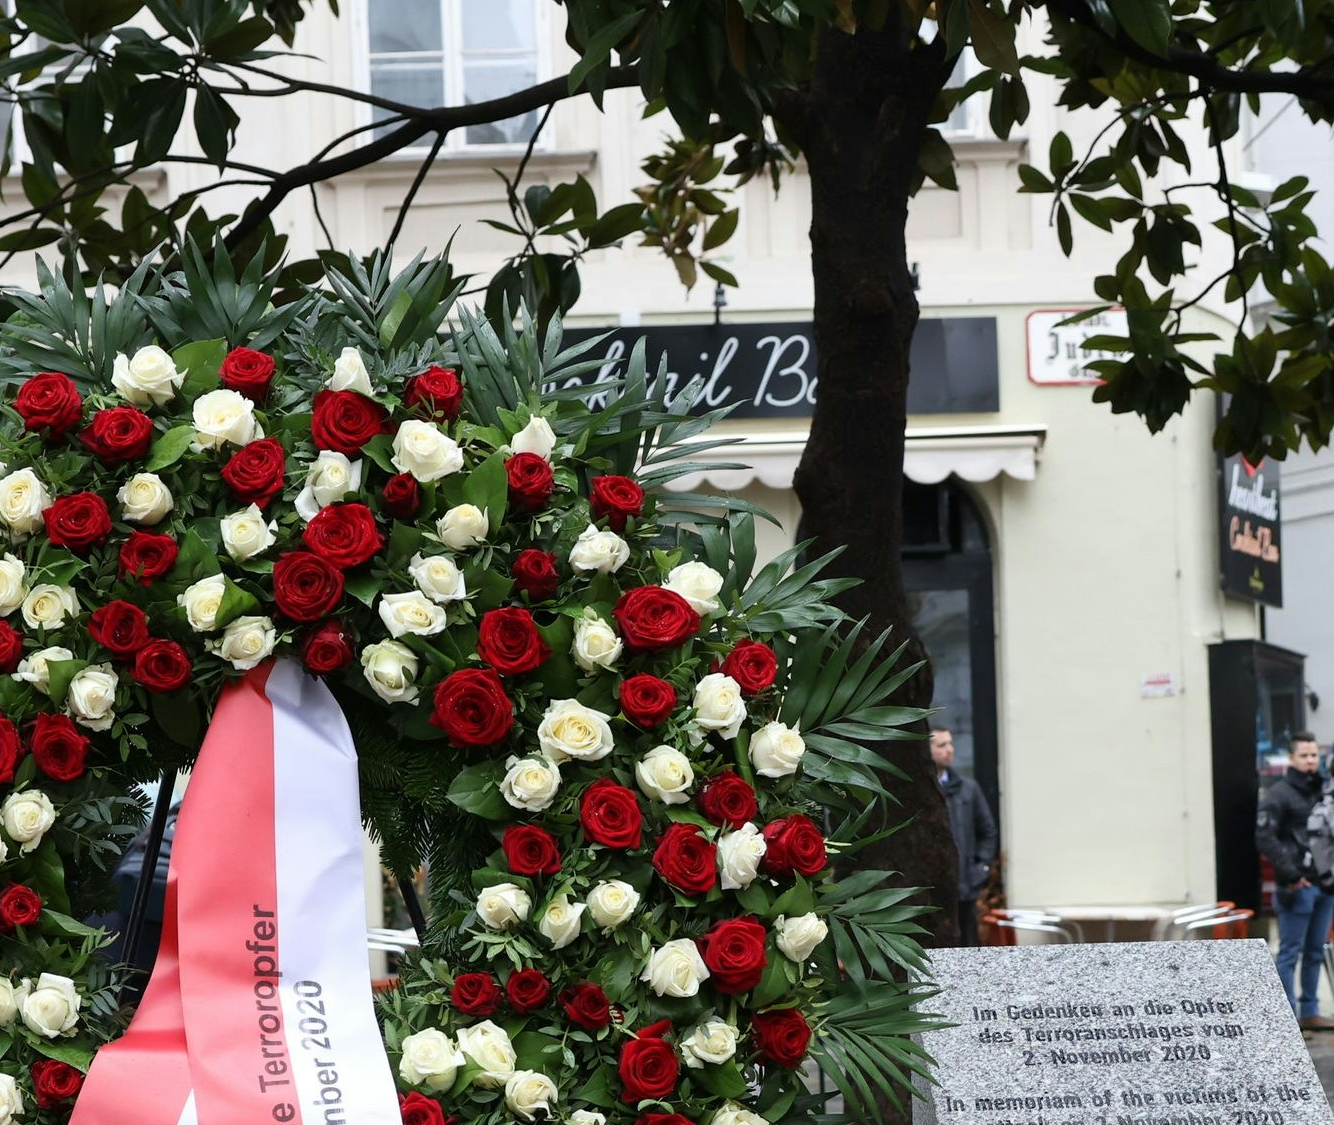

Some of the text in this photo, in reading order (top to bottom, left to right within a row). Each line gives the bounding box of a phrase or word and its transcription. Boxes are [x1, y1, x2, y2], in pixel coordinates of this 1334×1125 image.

[245, 904, 290, 1093] Terroropfer
[972, 998, 1234, 1020] Im Gedenken an die Opfer
[293, 980, 331, 1050] 2020
[978, 1022, 1244, 1043] des Terroranschlages vom
[1051, 1044, 1151, 1065] November
[1161, 1044, 1211, 1061] 2020
[946, 1084, 1311, 1112] In memoriam of the victims of the
